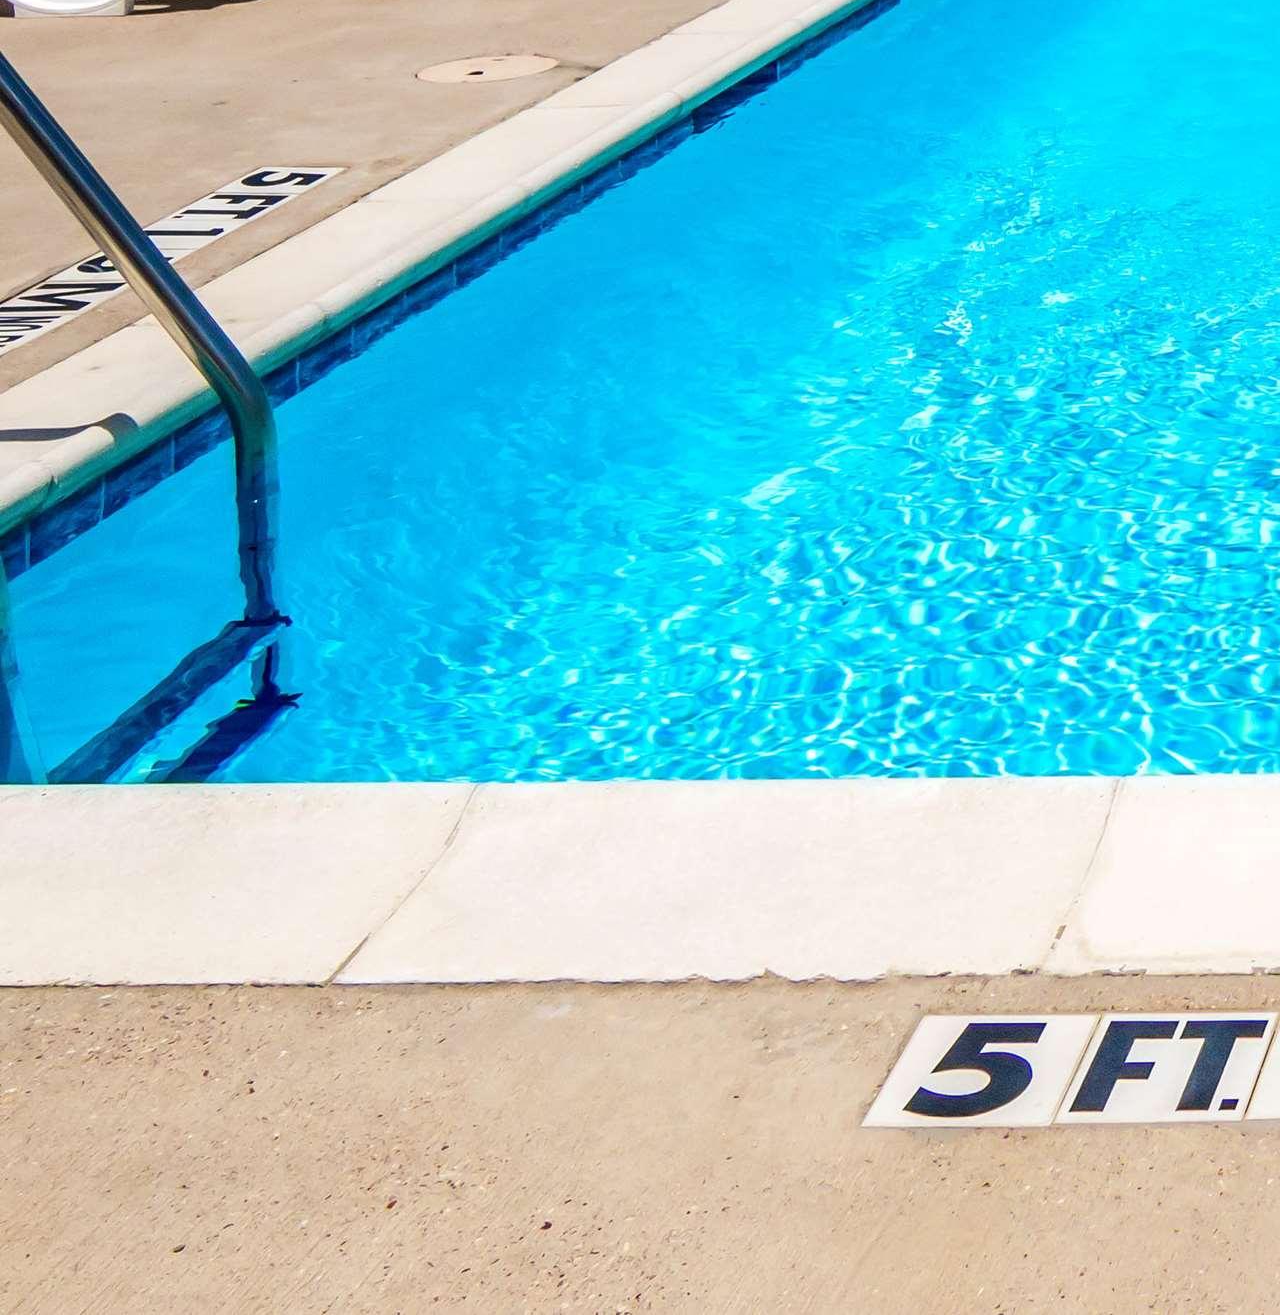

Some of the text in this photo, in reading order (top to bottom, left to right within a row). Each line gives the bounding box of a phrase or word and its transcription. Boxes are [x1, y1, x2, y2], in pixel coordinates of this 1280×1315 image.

[241, 171, 327, 186] 5
[172, 194, 289, 219] FT.
[902, 1022, 1048, 1117] 5
[1069, 1019, 1269, 1112] FT.
